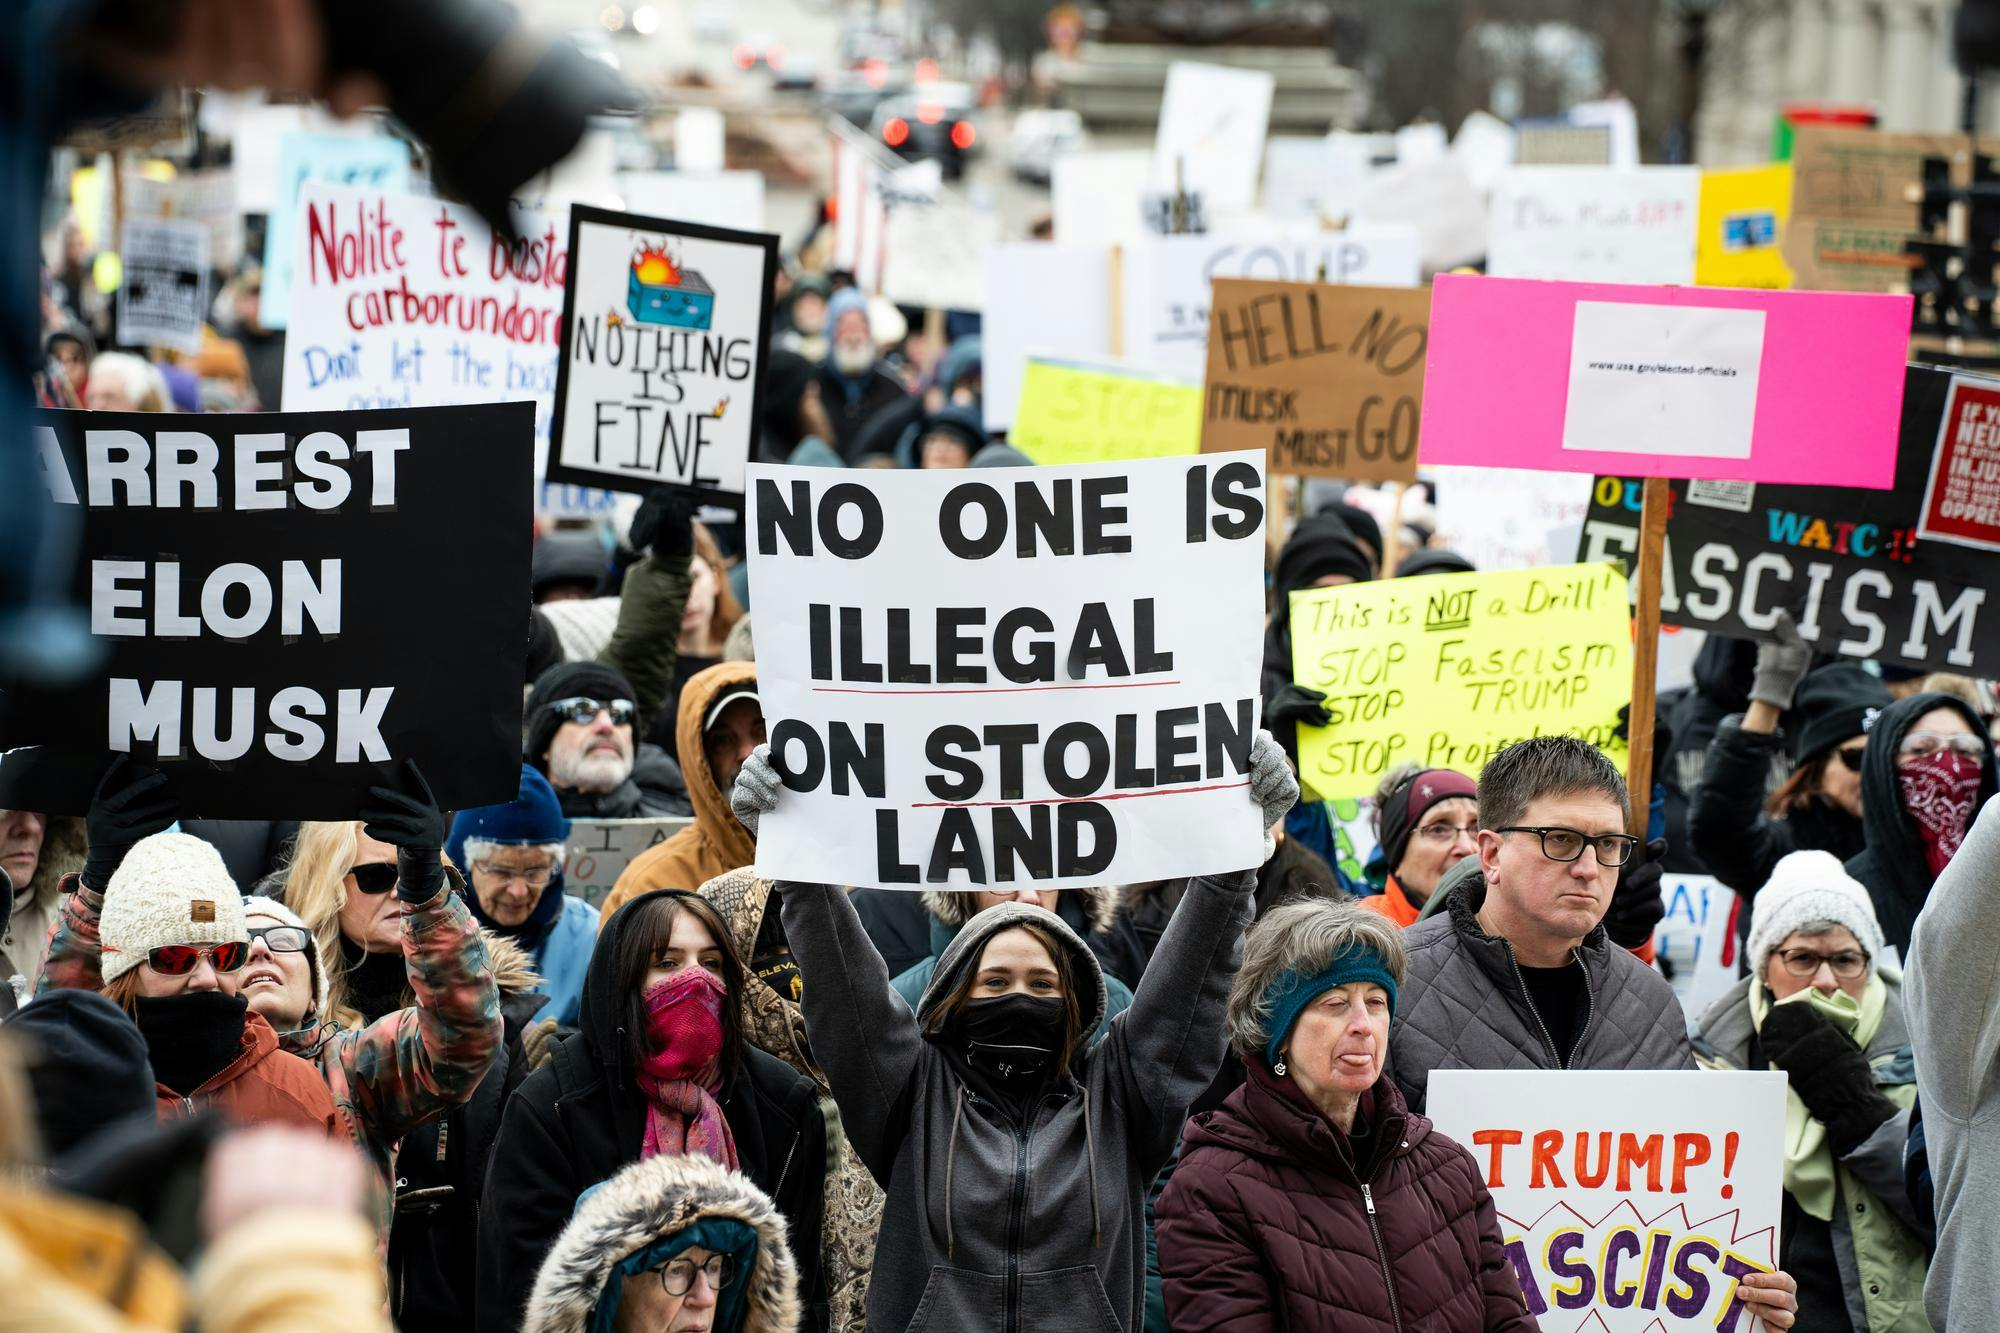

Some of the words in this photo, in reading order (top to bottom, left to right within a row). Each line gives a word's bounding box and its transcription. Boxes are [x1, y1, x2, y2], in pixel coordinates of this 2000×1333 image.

[308, 198, 405, 285] Nolite
[435, 206, 469, 278] te
[392, 338, 425, 383] let
[448, 342, 492, 387] the
[575, 316, 752, 381] NOTHING
[1219, 288, 1343, 372] HELL
[1349, 308, 1428, 377] NO
[632, 370, 684, 404] IS
[595, 401, 722, 485] FINE
[1273, 427, 1349, 469] MUST
[1355, 394, 1420, 463] GO
[755, 478, 884, 560] NO
[938, 475, 1132, 560] ONE
[1186, 461, 1264, 543] IS
[91, 558, 342, 638] ELON
[1311, 600, 1370, 632] This
[1388, 598, 1410, 625] is
[1426, 588, 1477, 627] NOT
[1489, 598, 1508, 617] a
[808, 597, 1174, 684] ILLEGAL
[1317, 642, 1406, 687] STOP
[1435, 639, 1616, 682] Fascism
[109, 677, 395, 764] MUSK
[1325, 688, 1404, 725] STOP
[1464, 675, 1589, 713] TRUMP
[770, 718, 886, 798] ON
[924, 698, 1254, 801] STOLEN
[1318, 733, 1406, 775] STOP
[587, 825, 621, 852] I
[875, 802, 1118, 884] LAND
[1472, 1128, 1740, 1200] TRUMP!
